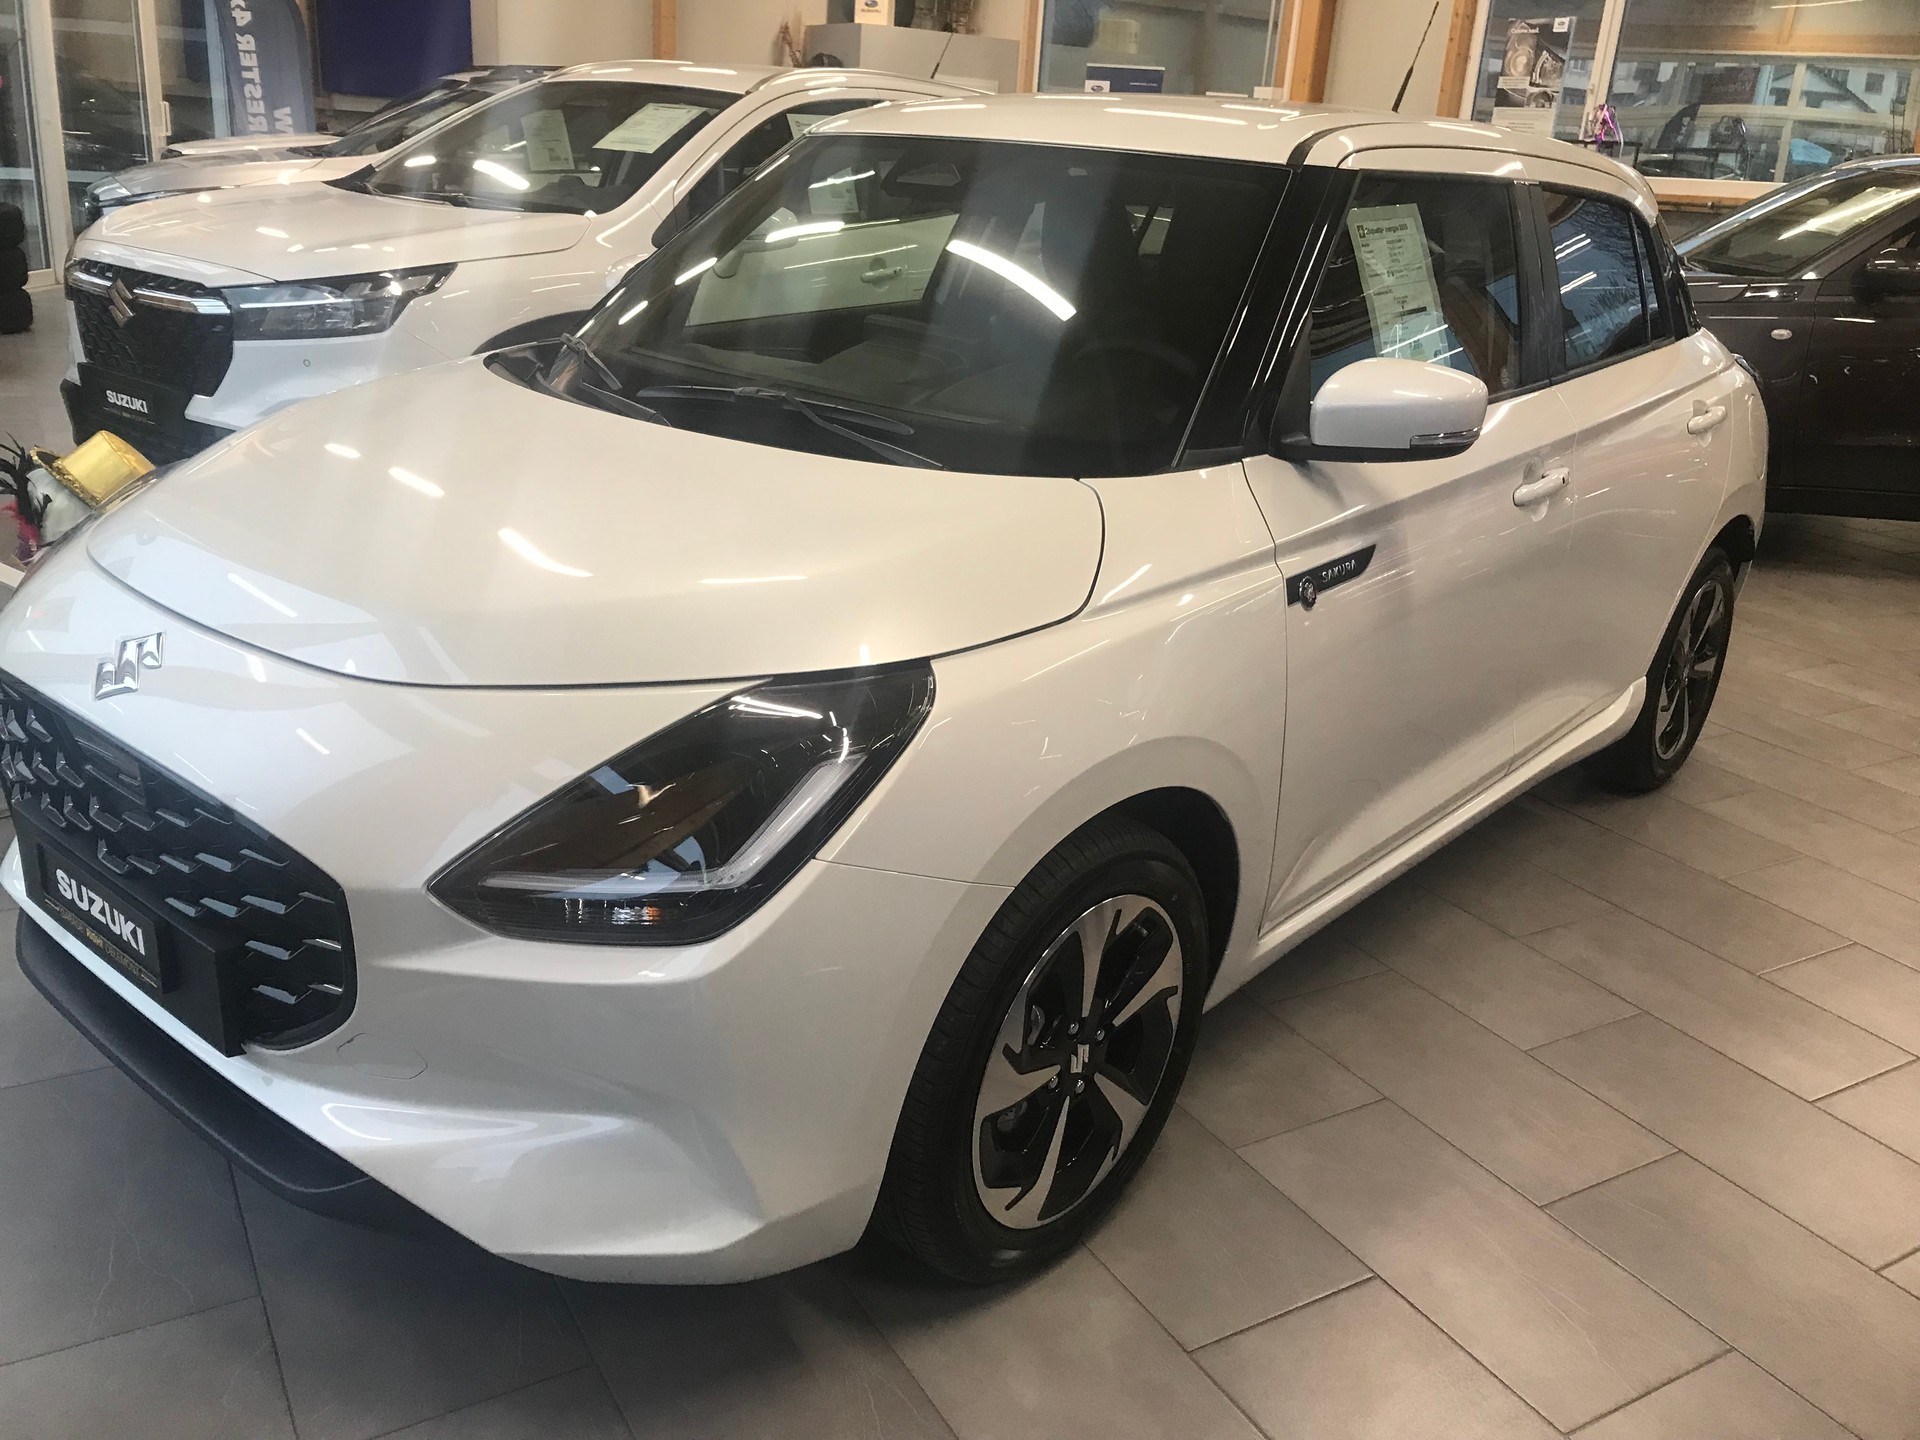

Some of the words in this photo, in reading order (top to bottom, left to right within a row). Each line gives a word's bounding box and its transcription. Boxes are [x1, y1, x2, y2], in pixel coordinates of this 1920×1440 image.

[105, 389, 149, 413] SUZUKI
[1321, 559, 1357, 583] SAKURA
[55, 868, 146, 956] SUZUKI
